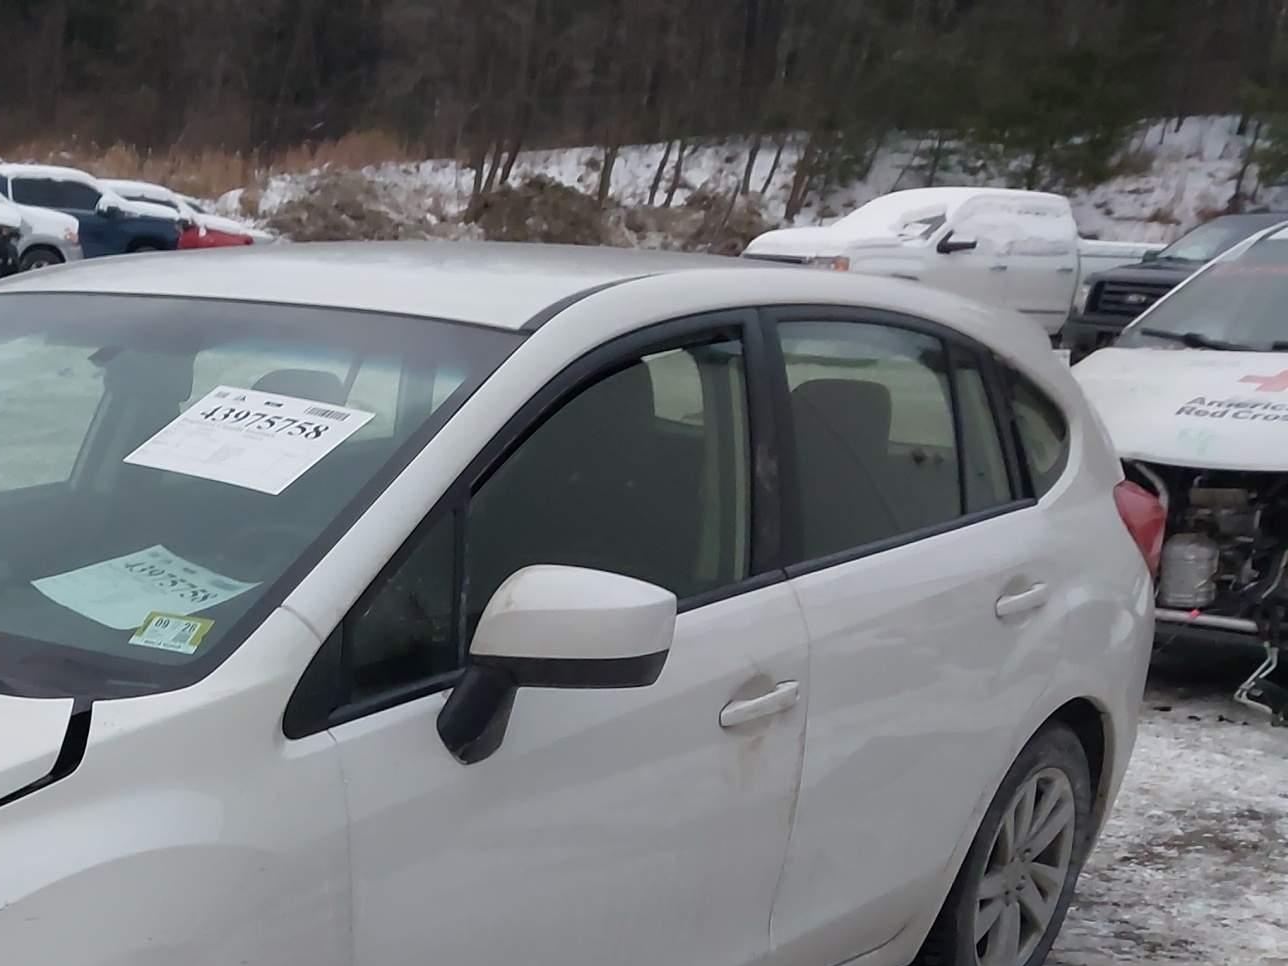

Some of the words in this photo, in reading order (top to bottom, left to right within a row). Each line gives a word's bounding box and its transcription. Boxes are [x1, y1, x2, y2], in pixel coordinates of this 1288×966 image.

[1185, 396, 1288, 412] Americ
[1175, 405, 1232, 419] Red
[200, 404, 330, 441] 43975758
[154, 617, 171, 630] 09
